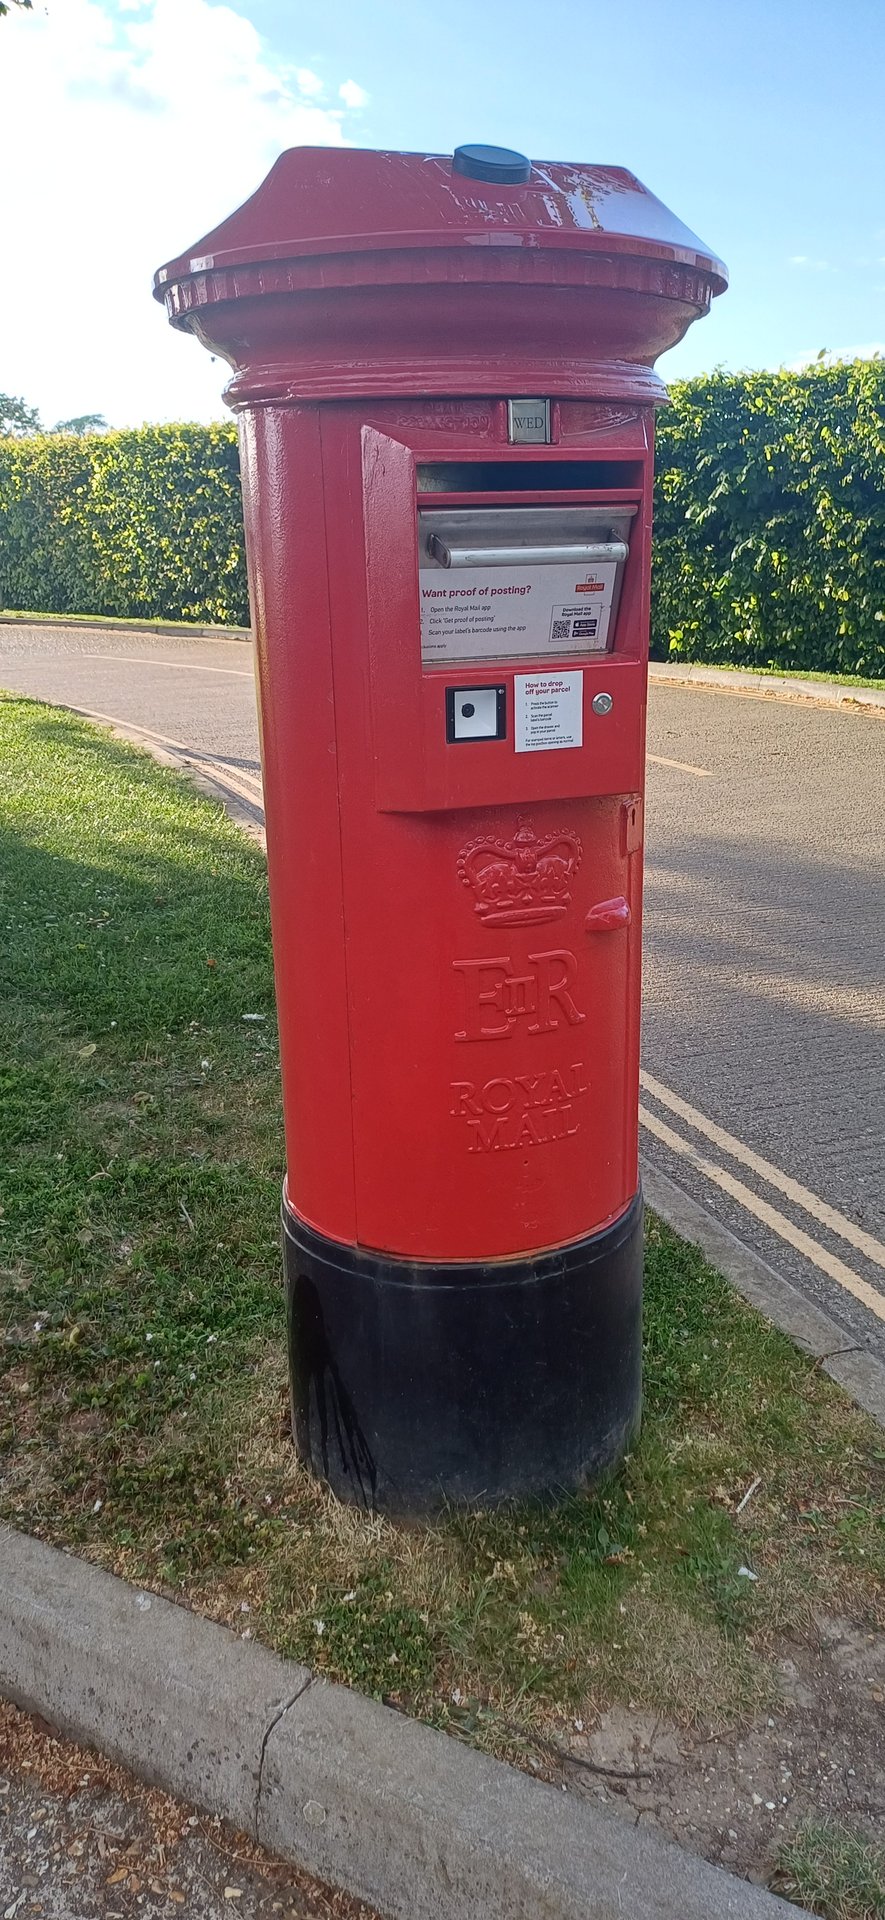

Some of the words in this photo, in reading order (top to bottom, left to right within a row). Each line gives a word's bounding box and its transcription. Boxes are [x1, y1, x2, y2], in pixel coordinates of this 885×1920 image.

[514, 417, 543, 429] WED
[422, 589, 446, 598] Want
[449, 588, 476, 598] proof
[478, 587, 489, 595] of
[490, 585, 531, 596] posting?
[450, 1062, 591, 1116] ROYAL
[467, 1104, 580, 1153] MAIL
